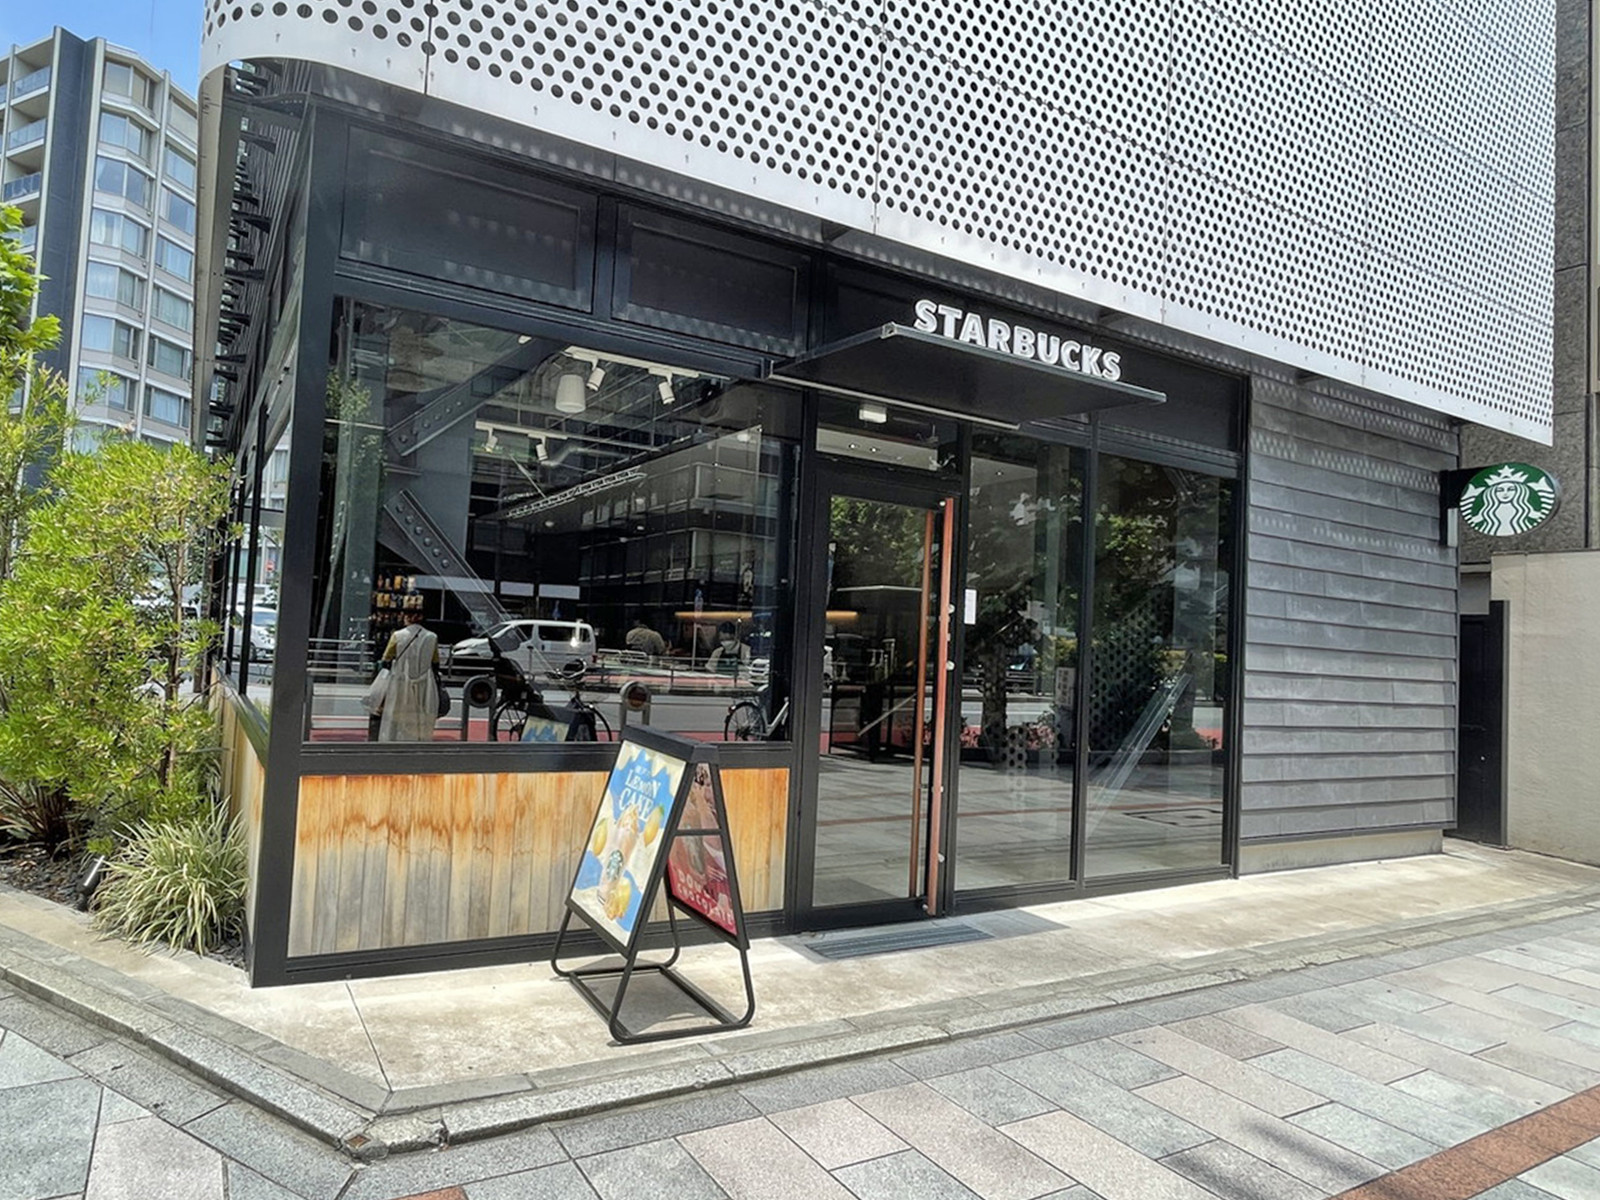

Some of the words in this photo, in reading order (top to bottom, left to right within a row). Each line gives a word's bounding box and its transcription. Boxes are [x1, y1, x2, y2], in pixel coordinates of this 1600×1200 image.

[914, 299, 1122, 382] STARBUCKS
[625, 769, 662, 799] LEMON
[618, 786, 655, 822] CAKE
